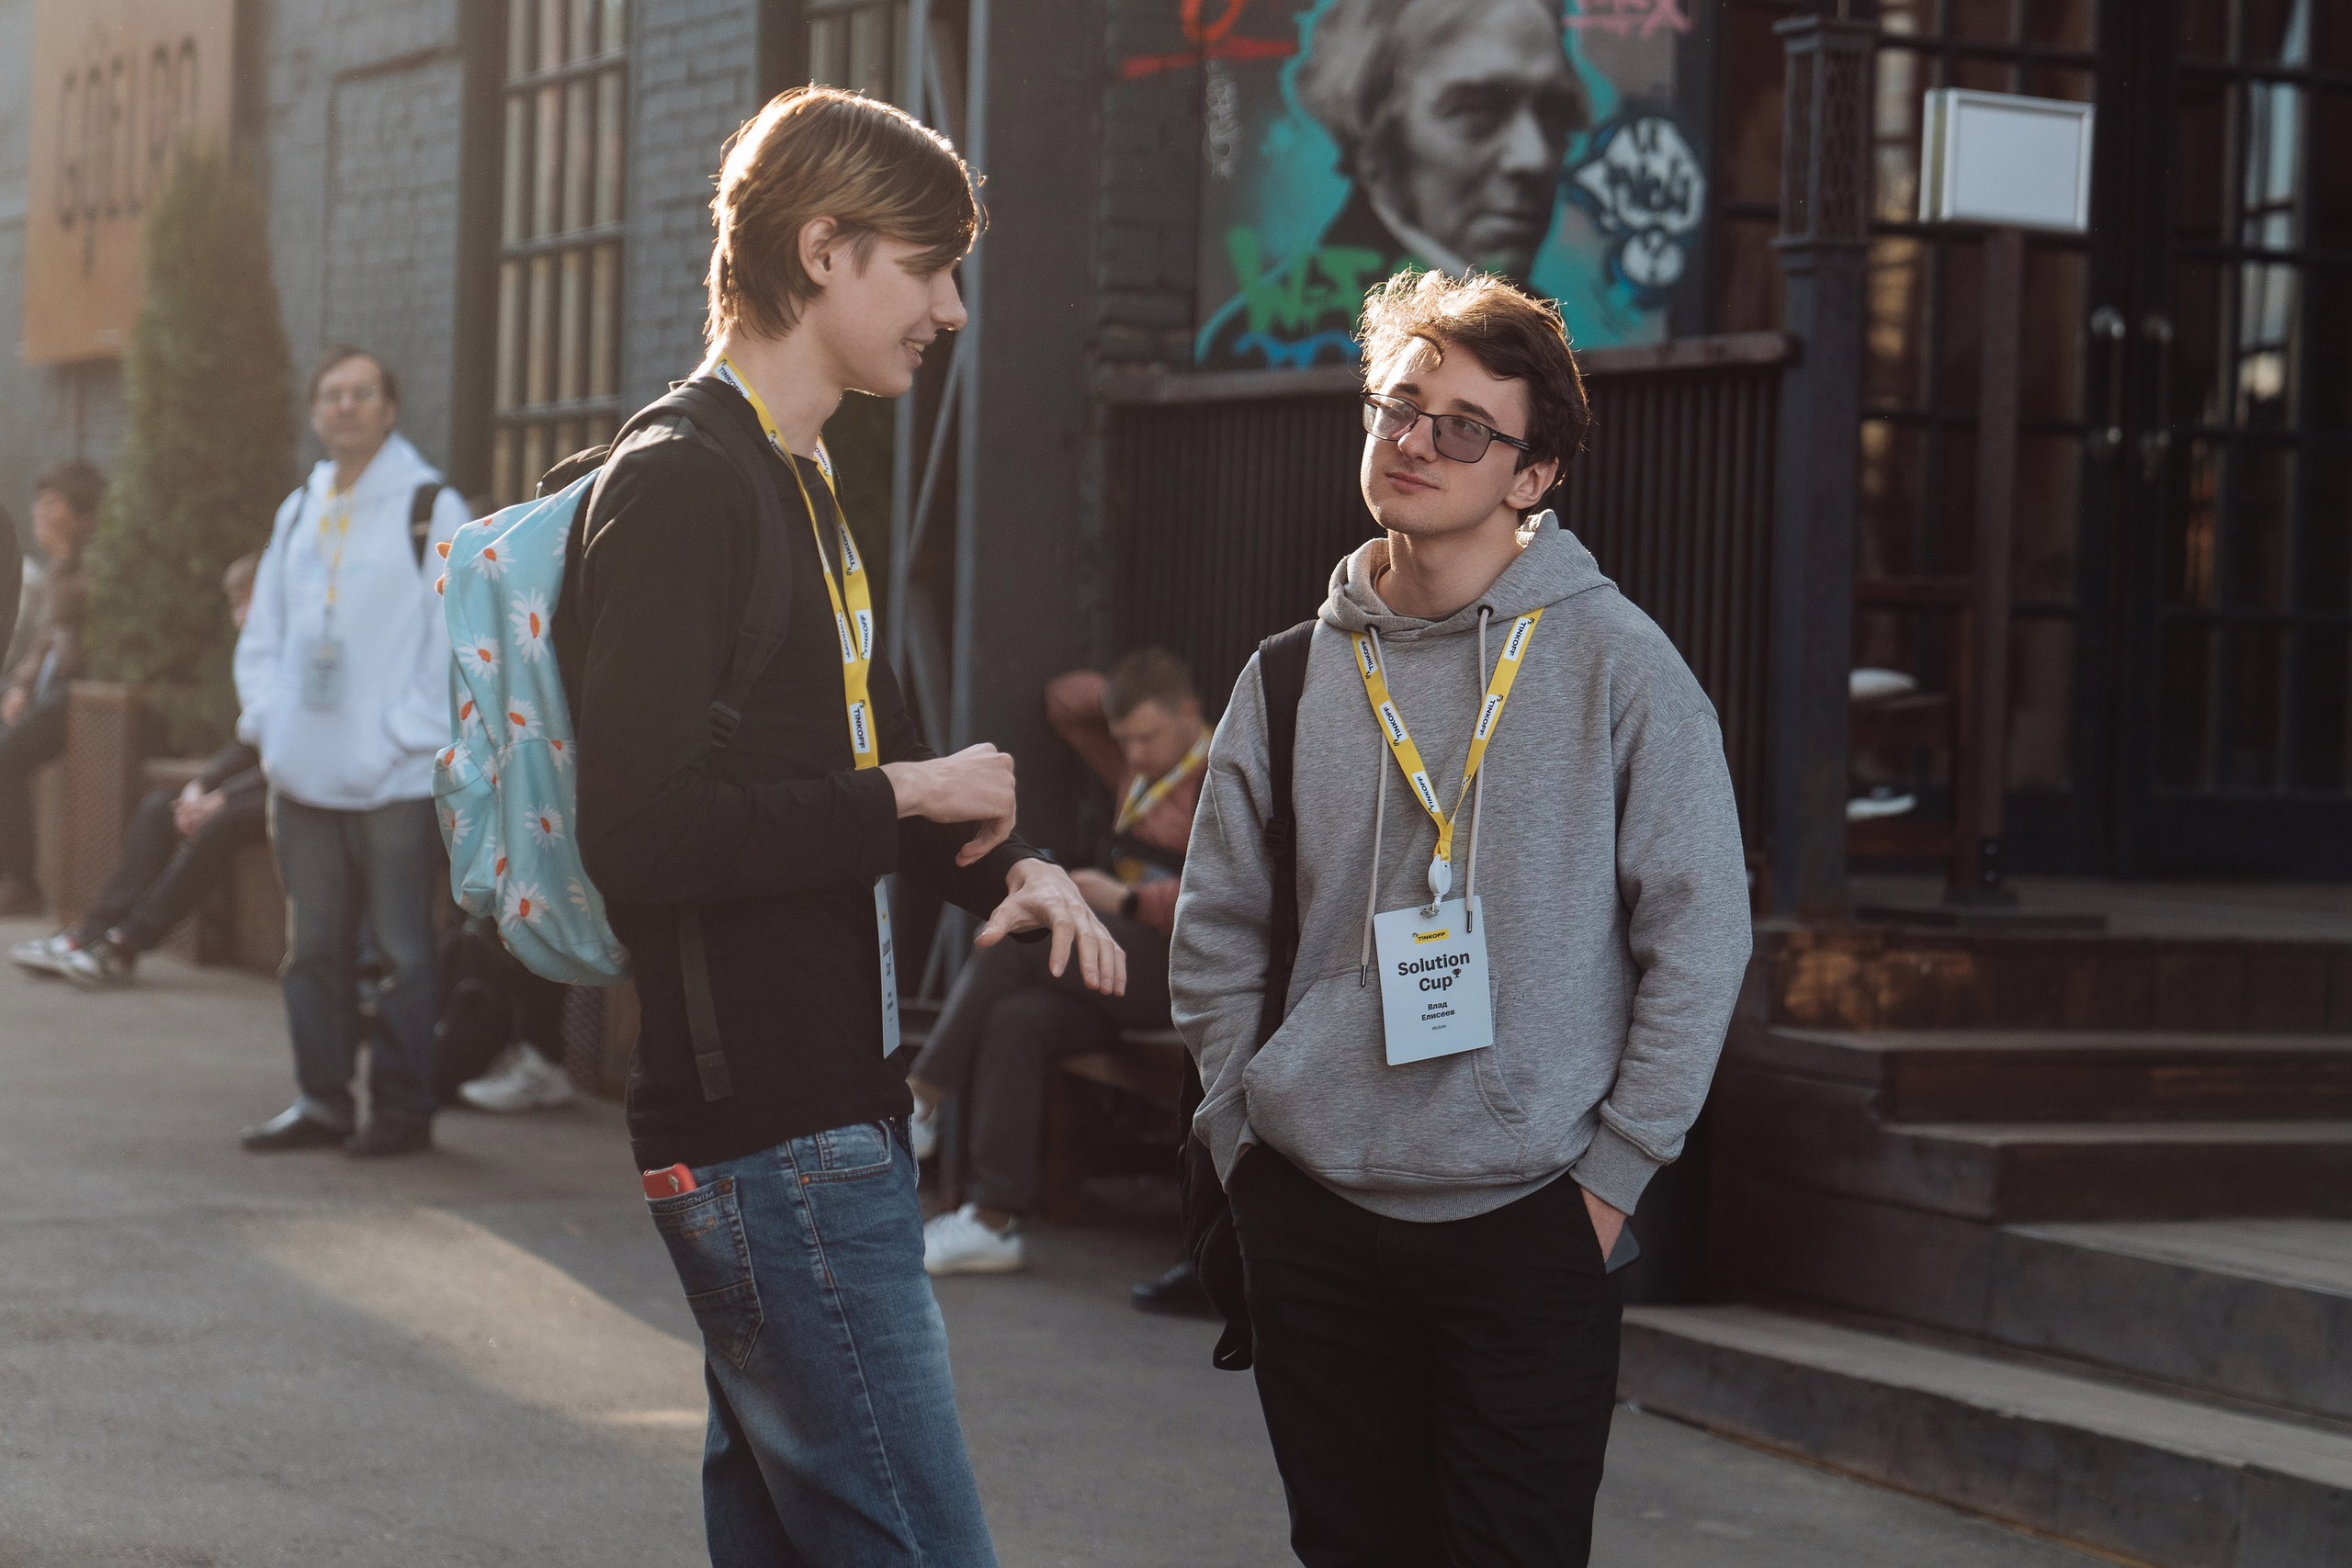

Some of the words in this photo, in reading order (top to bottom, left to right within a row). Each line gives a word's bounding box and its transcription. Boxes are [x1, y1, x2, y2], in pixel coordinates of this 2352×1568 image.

[1510, 622, 1526, 656] TINKOFF
[1361, 640, 1374, 671] TINKOFF
[854, 707, 865, 749] TINKOFF
[1383, 706, 1402, 739] TINKOFF
[1479, 699, 1496, 736] TINKOFF
[1416, 776, 1434, 809] TINKOFF
[1418, 931, 1446, 941] TINKOFF
[1397, 953, 1470, 976] Solution
[1419, 976, 1453, 991] Cup
[1421, 1010, 1455, 1021] Елисеев
[1428, 1001, 1448, 1010] Влад
